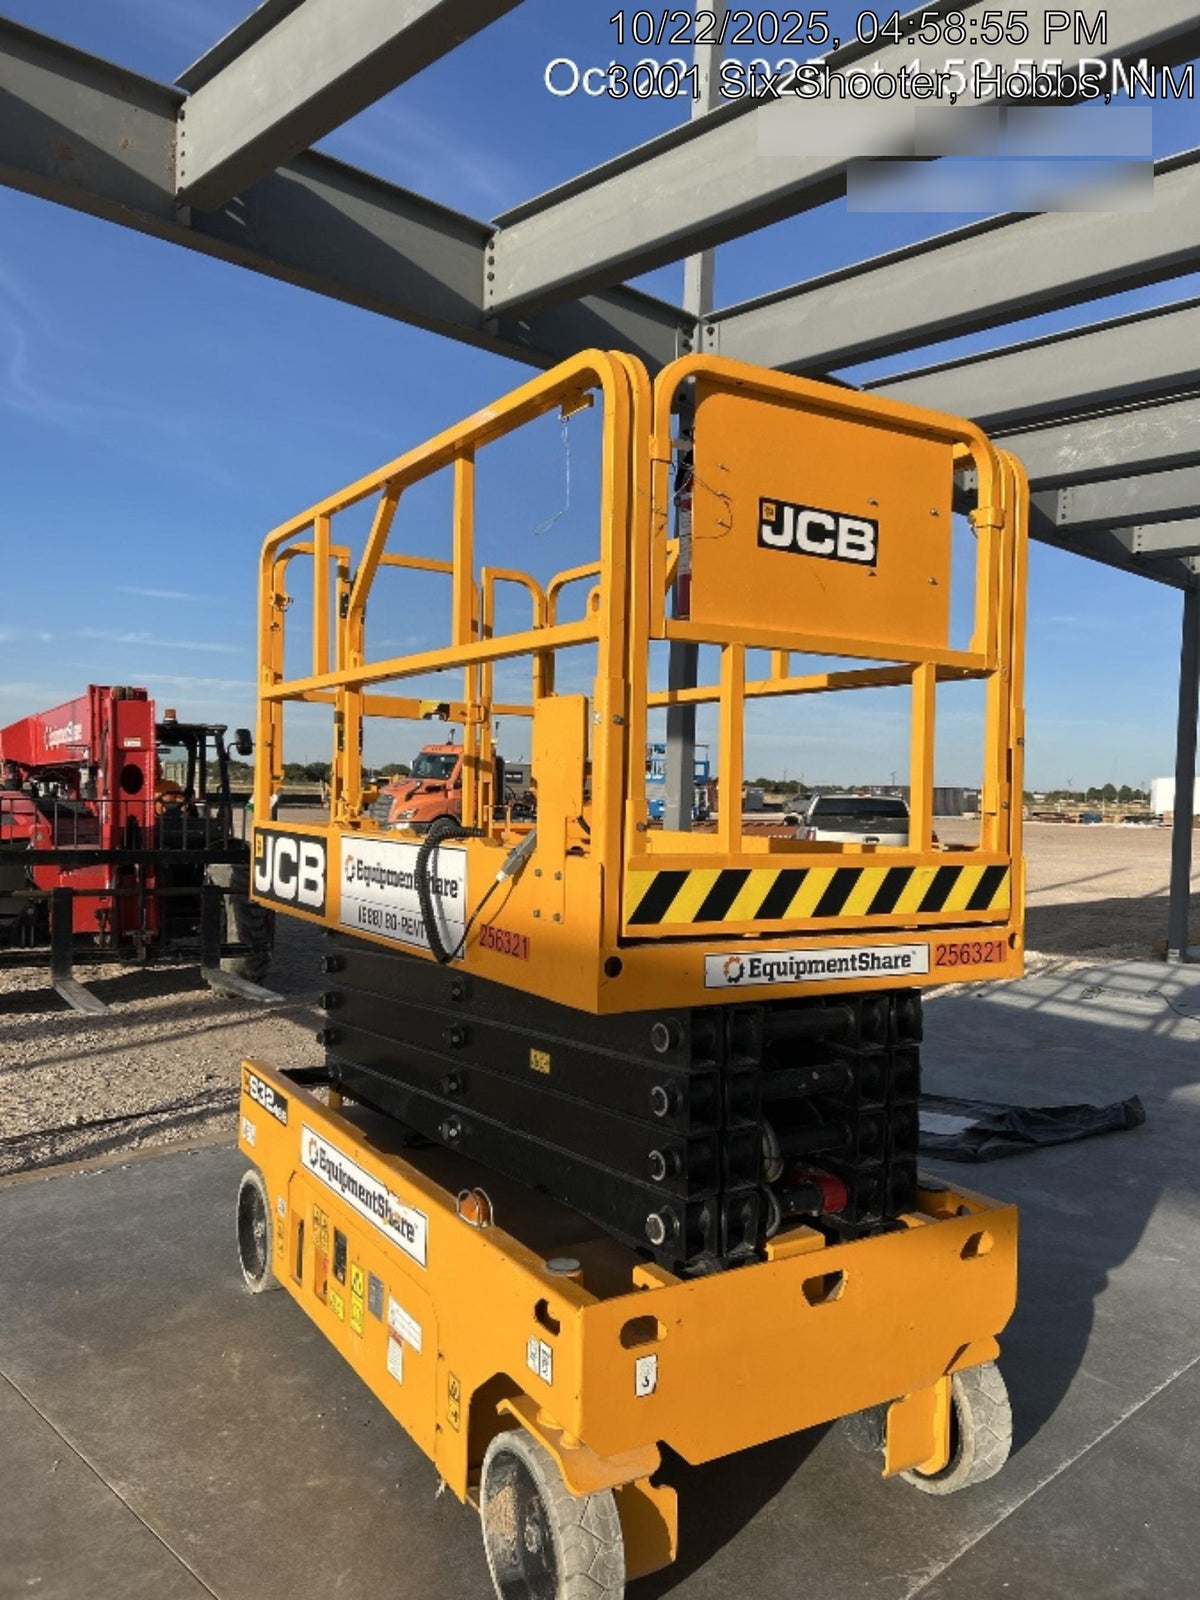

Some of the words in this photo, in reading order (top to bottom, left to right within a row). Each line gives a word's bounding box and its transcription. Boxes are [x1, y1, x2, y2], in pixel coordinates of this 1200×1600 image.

[761, 506, 876, 561] JCB
[255, 835, 325, 908] JCB
[480, 923, 528, 960] 256321
[936, 941, 1003, 966] 256321
[748, 951, 912, 981] EquipmentShare
